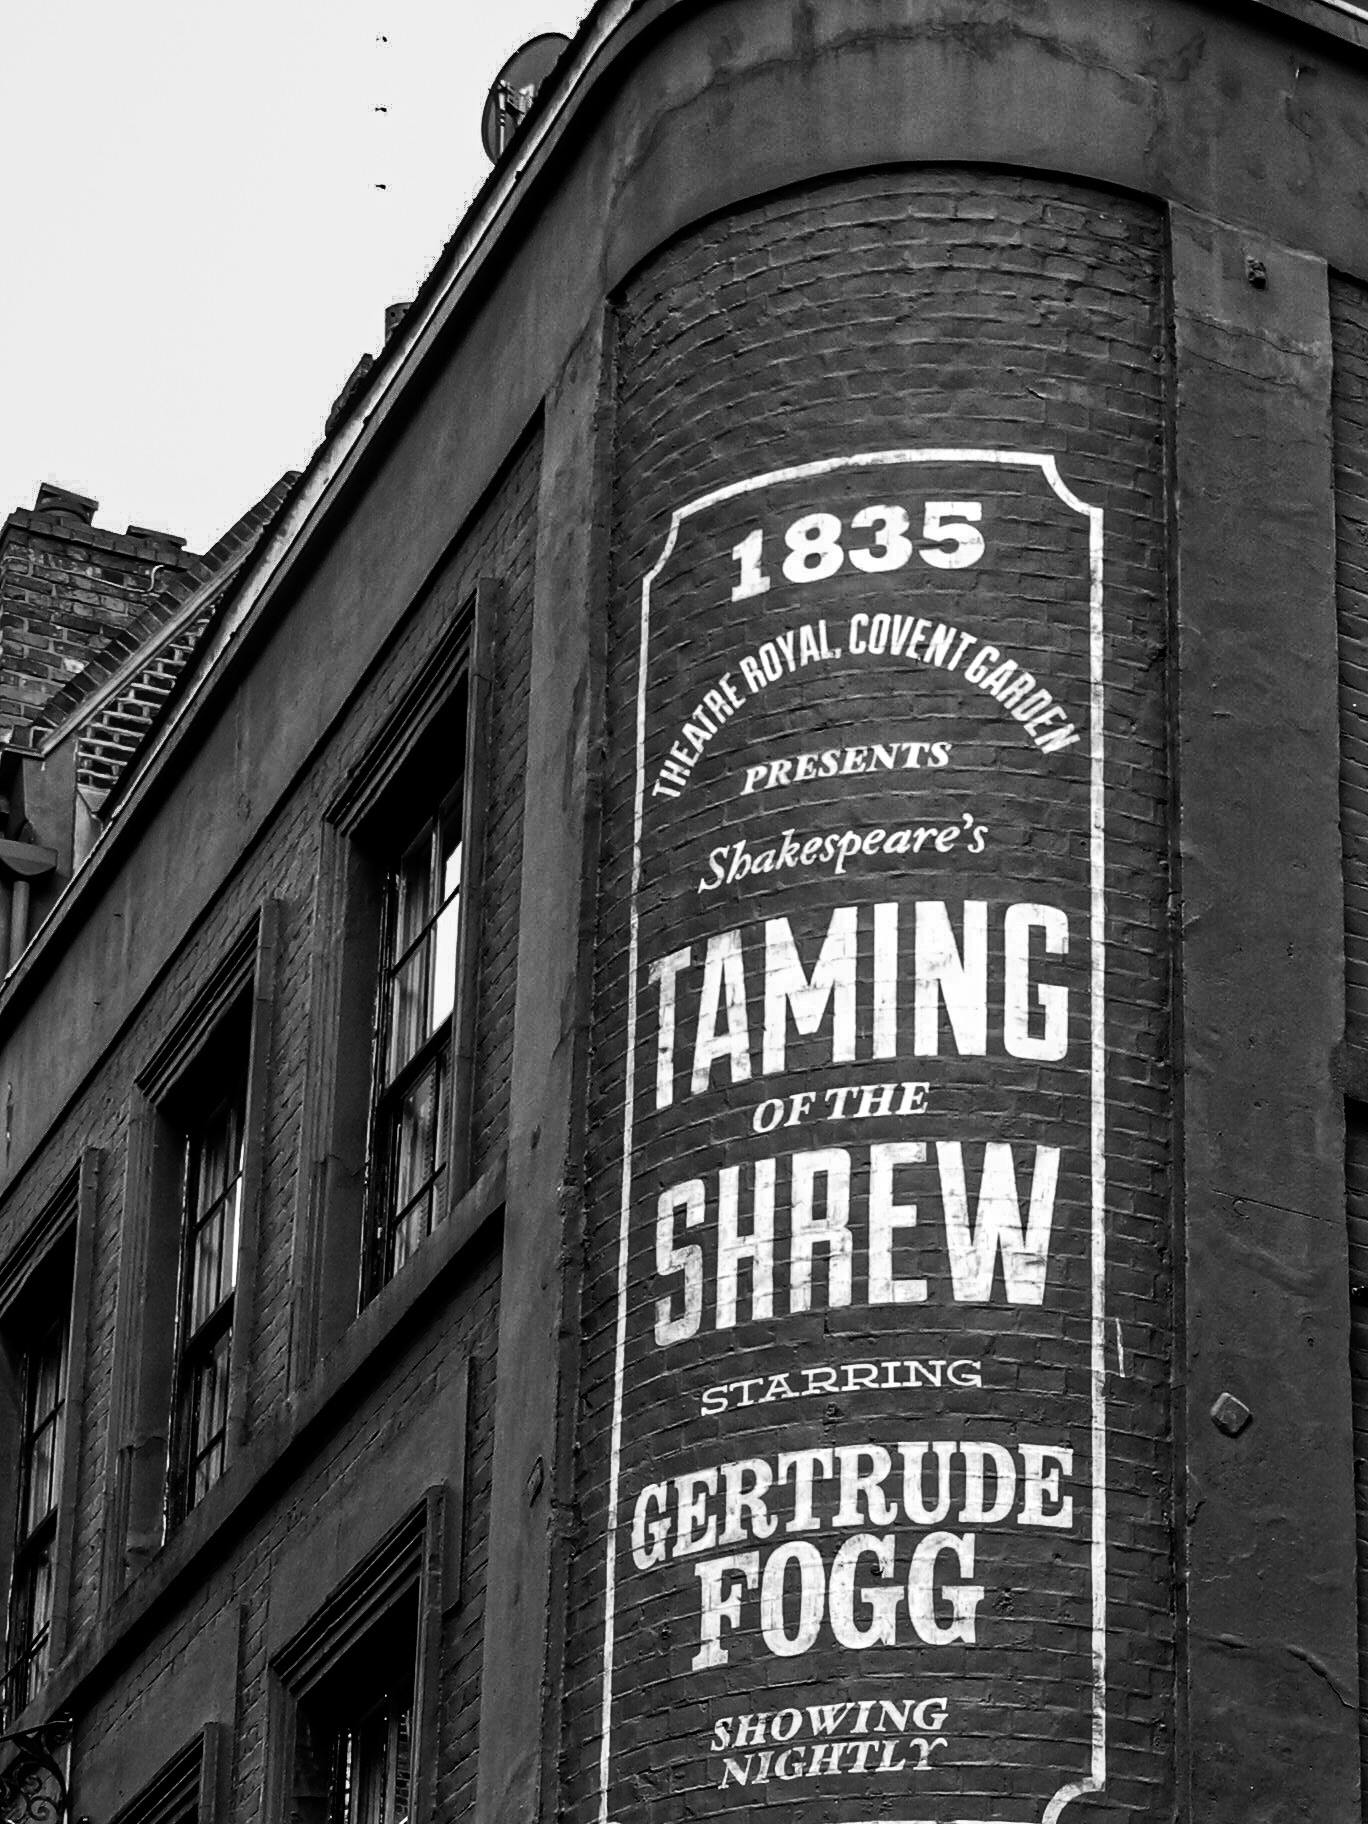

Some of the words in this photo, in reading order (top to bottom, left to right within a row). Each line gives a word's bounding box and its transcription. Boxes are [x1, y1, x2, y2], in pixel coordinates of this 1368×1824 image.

[731, 501, 985, 601] 1835
[652, 671, 747, 799] THEATRE
[848, 612, 983, 671] COVENT
[964, 645, 1081, 756] GARDEN
[739, 741, 953, 796] PRESENTS
[697, 812, 989, 894] Shakespeare's
[648, 899, 1069, 1110] TAMING
[752, 1091, 817, 1133] OF
[823, 1081, 931, 1119] THE
[653, 1140, 1061, 1347] SHREW
[700, 1359, 983, 1417] STARRING
[630, 1440, 1075, 1571] GERTRUDE
[691, 1531, 985, 1673] FOGG
[711, 1697, 948, 1752] SHOWING
[718, 1737, 948, 1790] NIGHTLY
